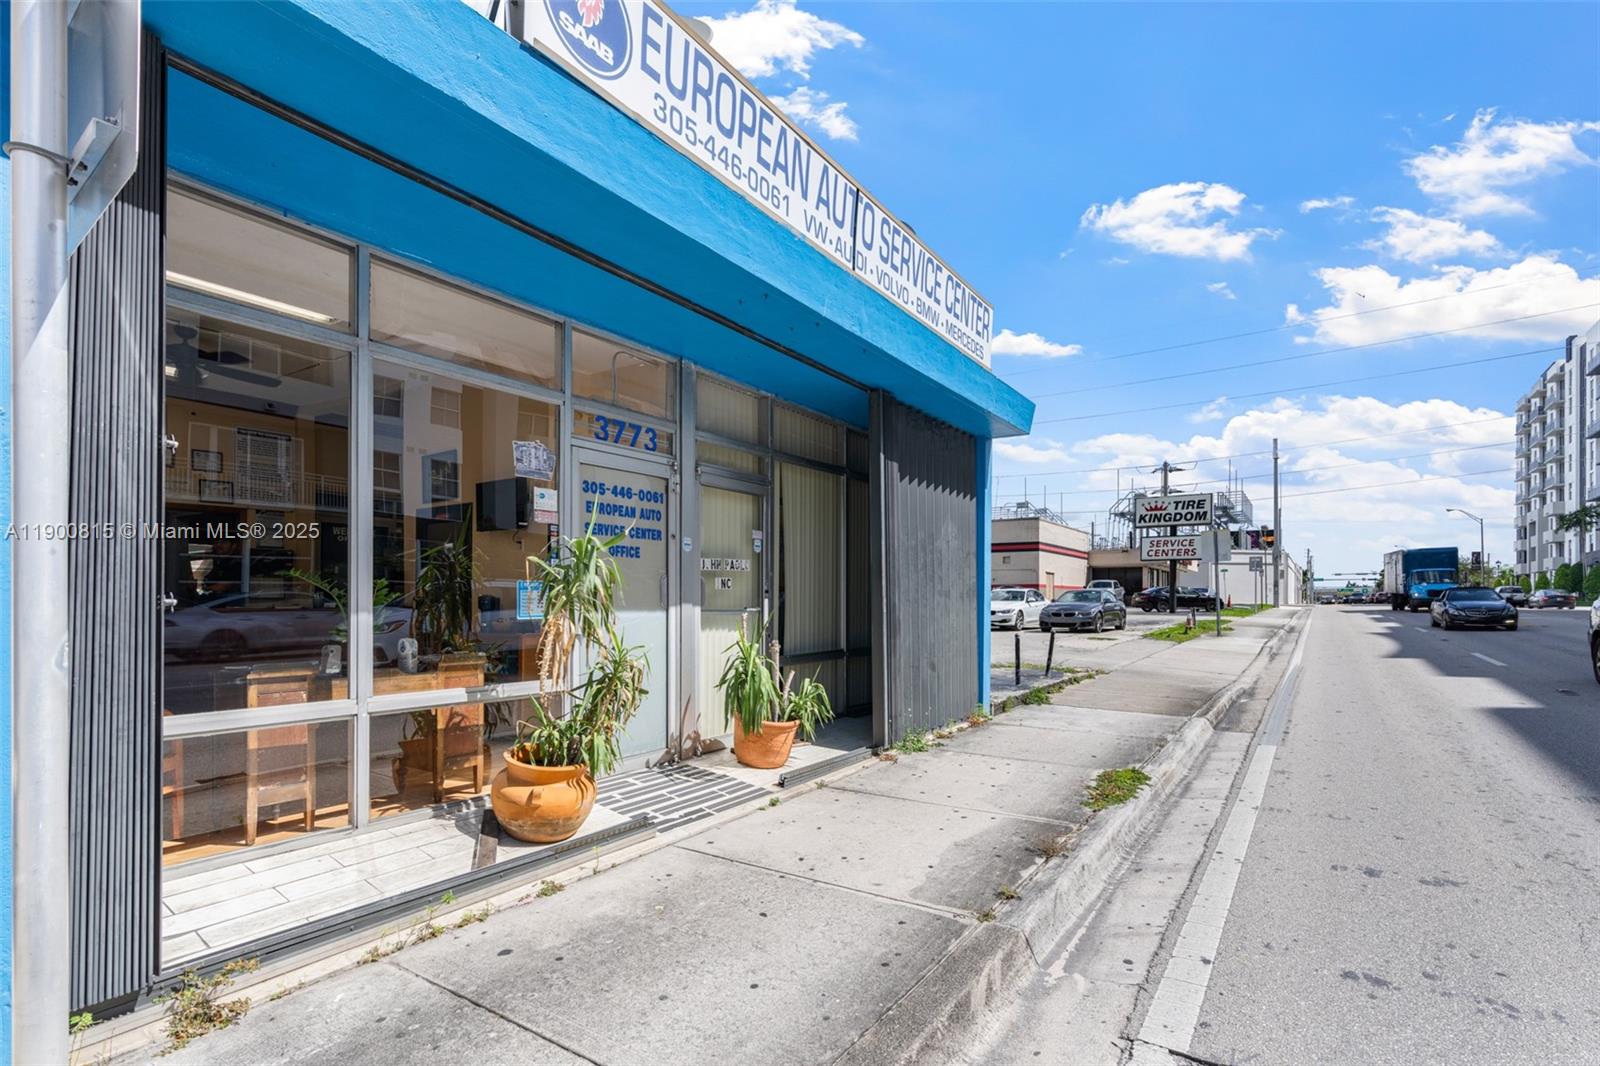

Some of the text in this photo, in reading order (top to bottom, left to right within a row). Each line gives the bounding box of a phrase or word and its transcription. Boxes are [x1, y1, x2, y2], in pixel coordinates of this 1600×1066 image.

[558, 11, 614, 66] SAAB
[640, 2, 991, 343] EUROPEAN AUTO SERVICE CENTER
[653, 91, 985, 361] 305-446-0061 VW AUDI VOLVO BMW MERCEDES
[594, 415, 657, 452] 3773
[582, 480, 664, 504] 305-446-0061
[1173, 500, 1207, 511] TIRE
[639, 508, 662, 521] AUTO
[1138, 511, 1208, 524] KINGDOM
[584, 523, 662, 540] SERVICE CENTER
[1149, 538, 1196, 548] SERVICE
[608, 546, 641, 558] OFFICE
[1146, 548, 1197, 558] CENTERS
